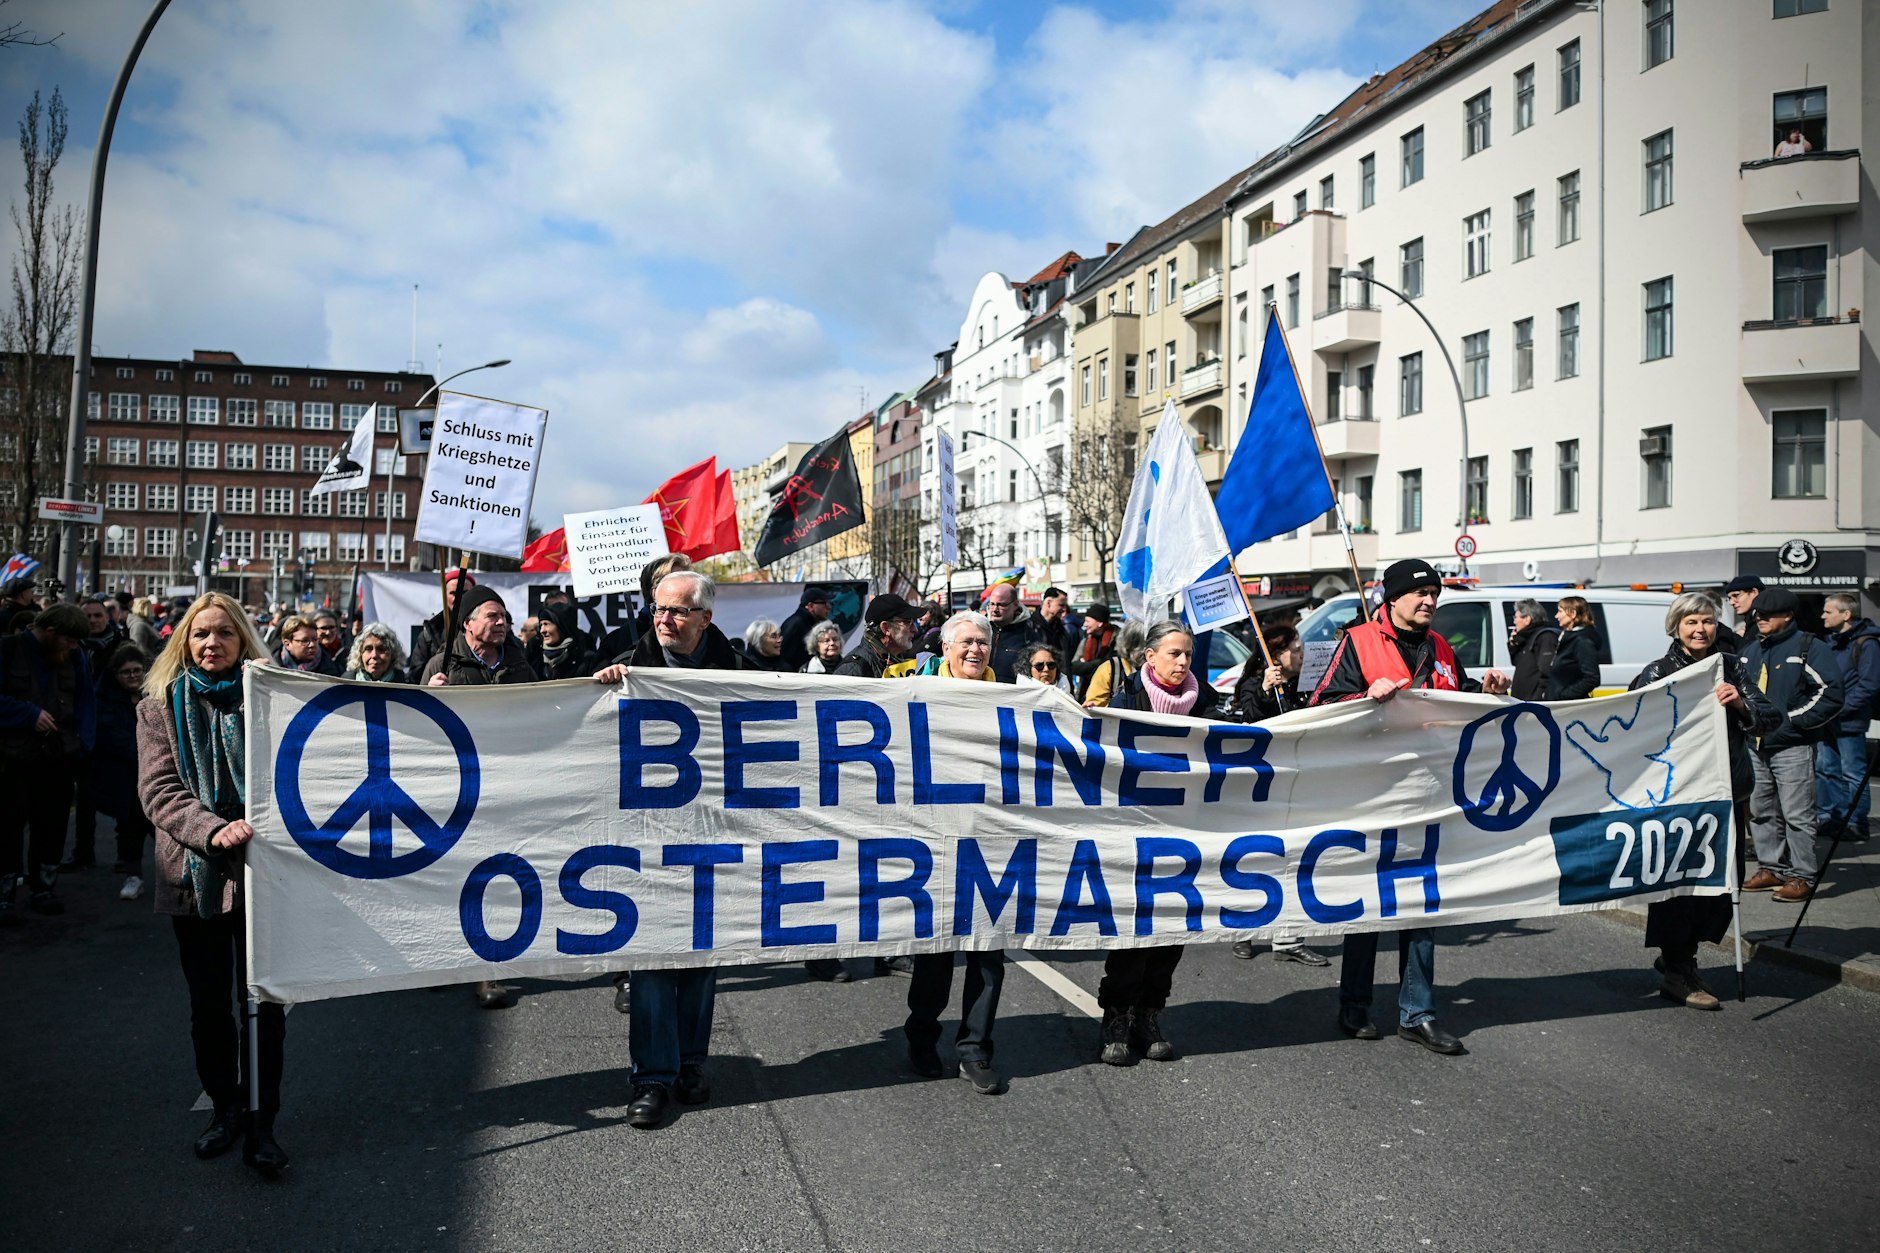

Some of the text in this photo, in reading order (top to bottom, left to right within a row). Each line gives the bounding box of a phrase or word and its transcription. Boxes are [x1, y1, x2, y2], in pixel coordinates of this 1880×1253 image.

[443, 419, 534, 448] Schluss mit
[437, 442, 531, 472] Kriegshetze
[465, 474, 497, 489] und
[430, 490, 521, 518] Sanktionen
[584, 515, 641, 529] Ehrlicher
[581, 525, 648, 541] Einsatz für
[576, 537, 658, 553] Verhandlun-
[1459, 541, 1473, 552] 30
[589, 550, 650, 565] gen ohne
[596, 576, 641, 589] gunge
[1780, 576, 1812, 585] COFFEE
[1813, 576, 1821, 585] &
[1822, 576, 1858, 585] WAFFLE
[1208, 587, 1226, 596] weltweit
[618, 699, 1275, 810] BERLINER
[1605, 814, 1719, 890] 2023
[458, 822, 1441, 963] OSTERMARSCH
